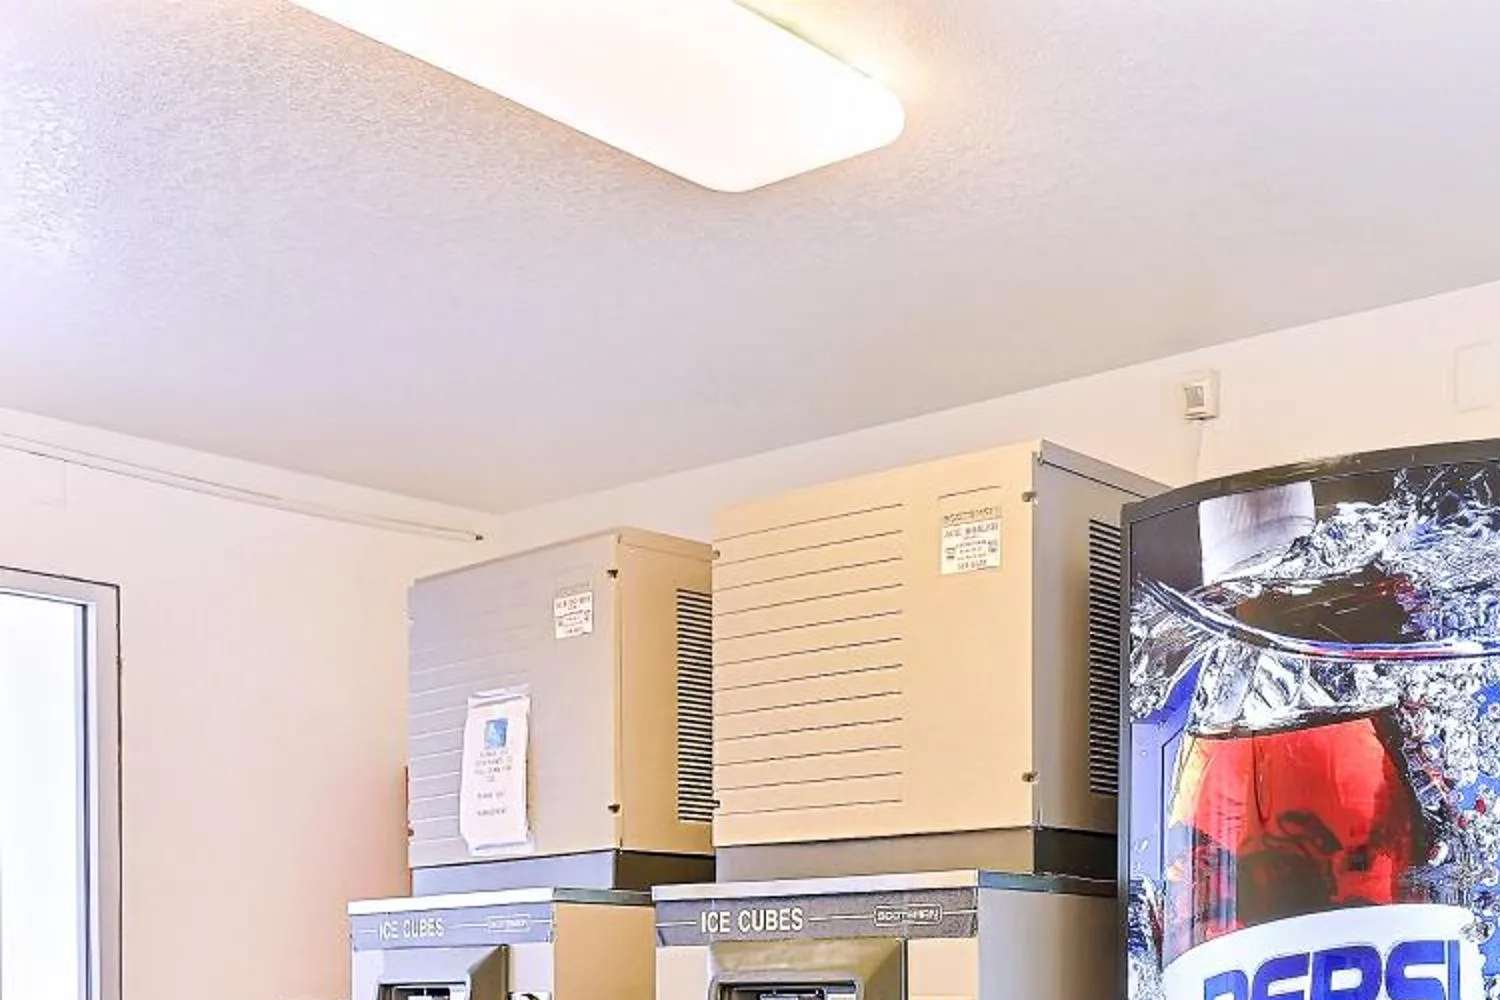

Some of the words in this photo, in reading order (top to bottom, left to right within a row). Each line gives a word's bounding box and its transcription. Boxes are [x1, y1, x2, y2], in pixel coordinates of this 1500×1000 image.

[379, 921, 400, 940] ICE
[403, 918, 445, 939] CUBES
[701, 910, 731, 933] ICE
[737, 908, 803, 932] CUBES
